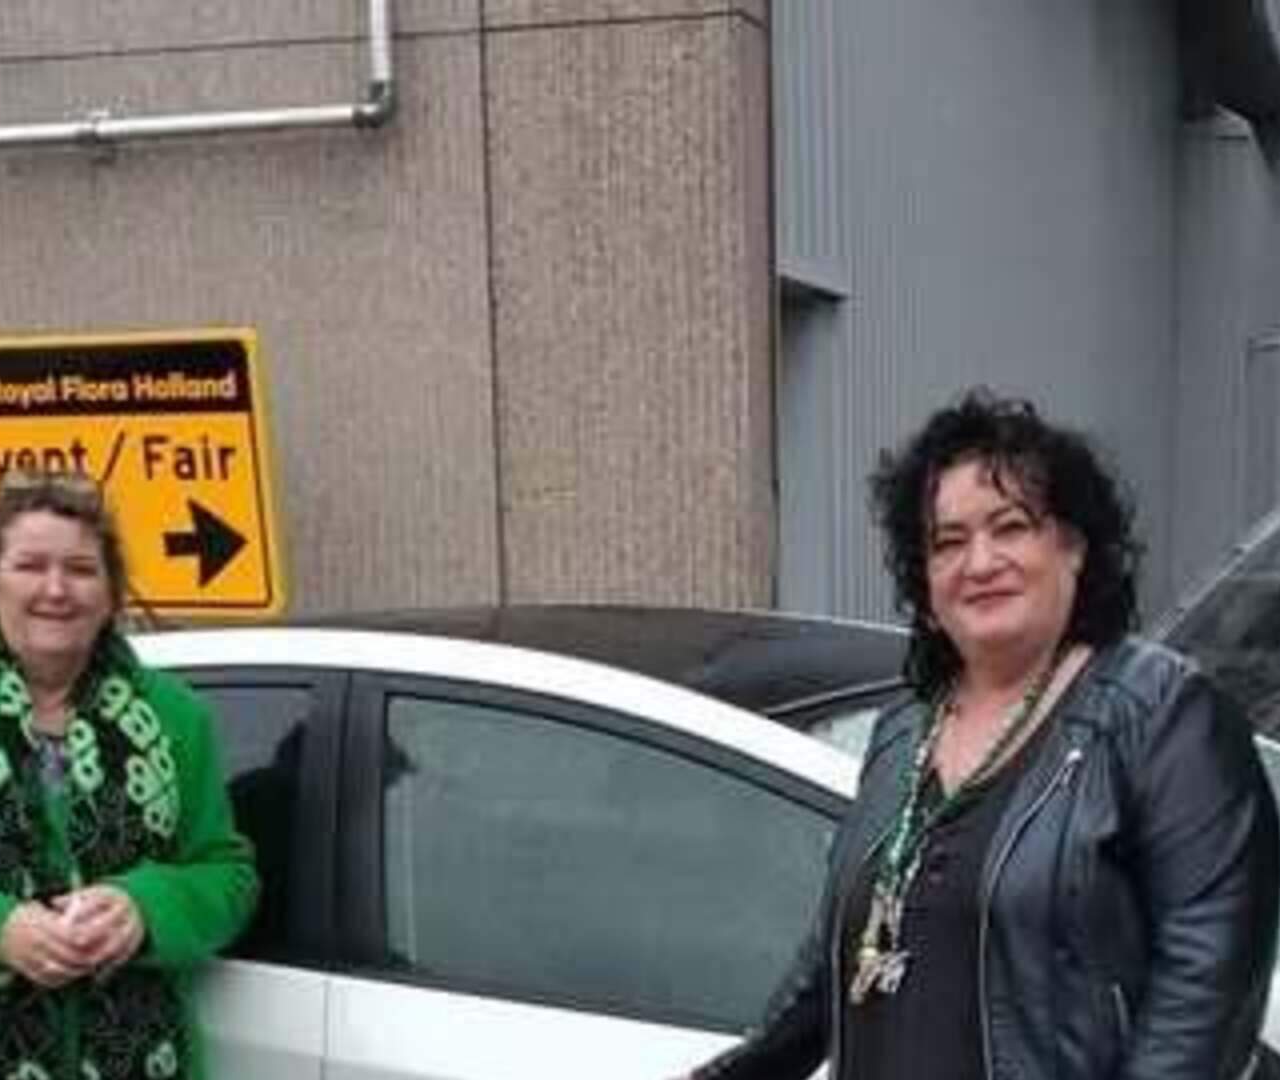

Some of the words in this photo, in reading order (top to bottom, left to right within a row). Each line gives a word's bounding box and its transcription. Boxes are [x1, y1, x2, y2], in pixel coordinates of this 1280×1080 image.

[62, 373, 129, 401] Flora
[132, 370, 237, 399] Holland
[141, 434, 237, 481] Fair
